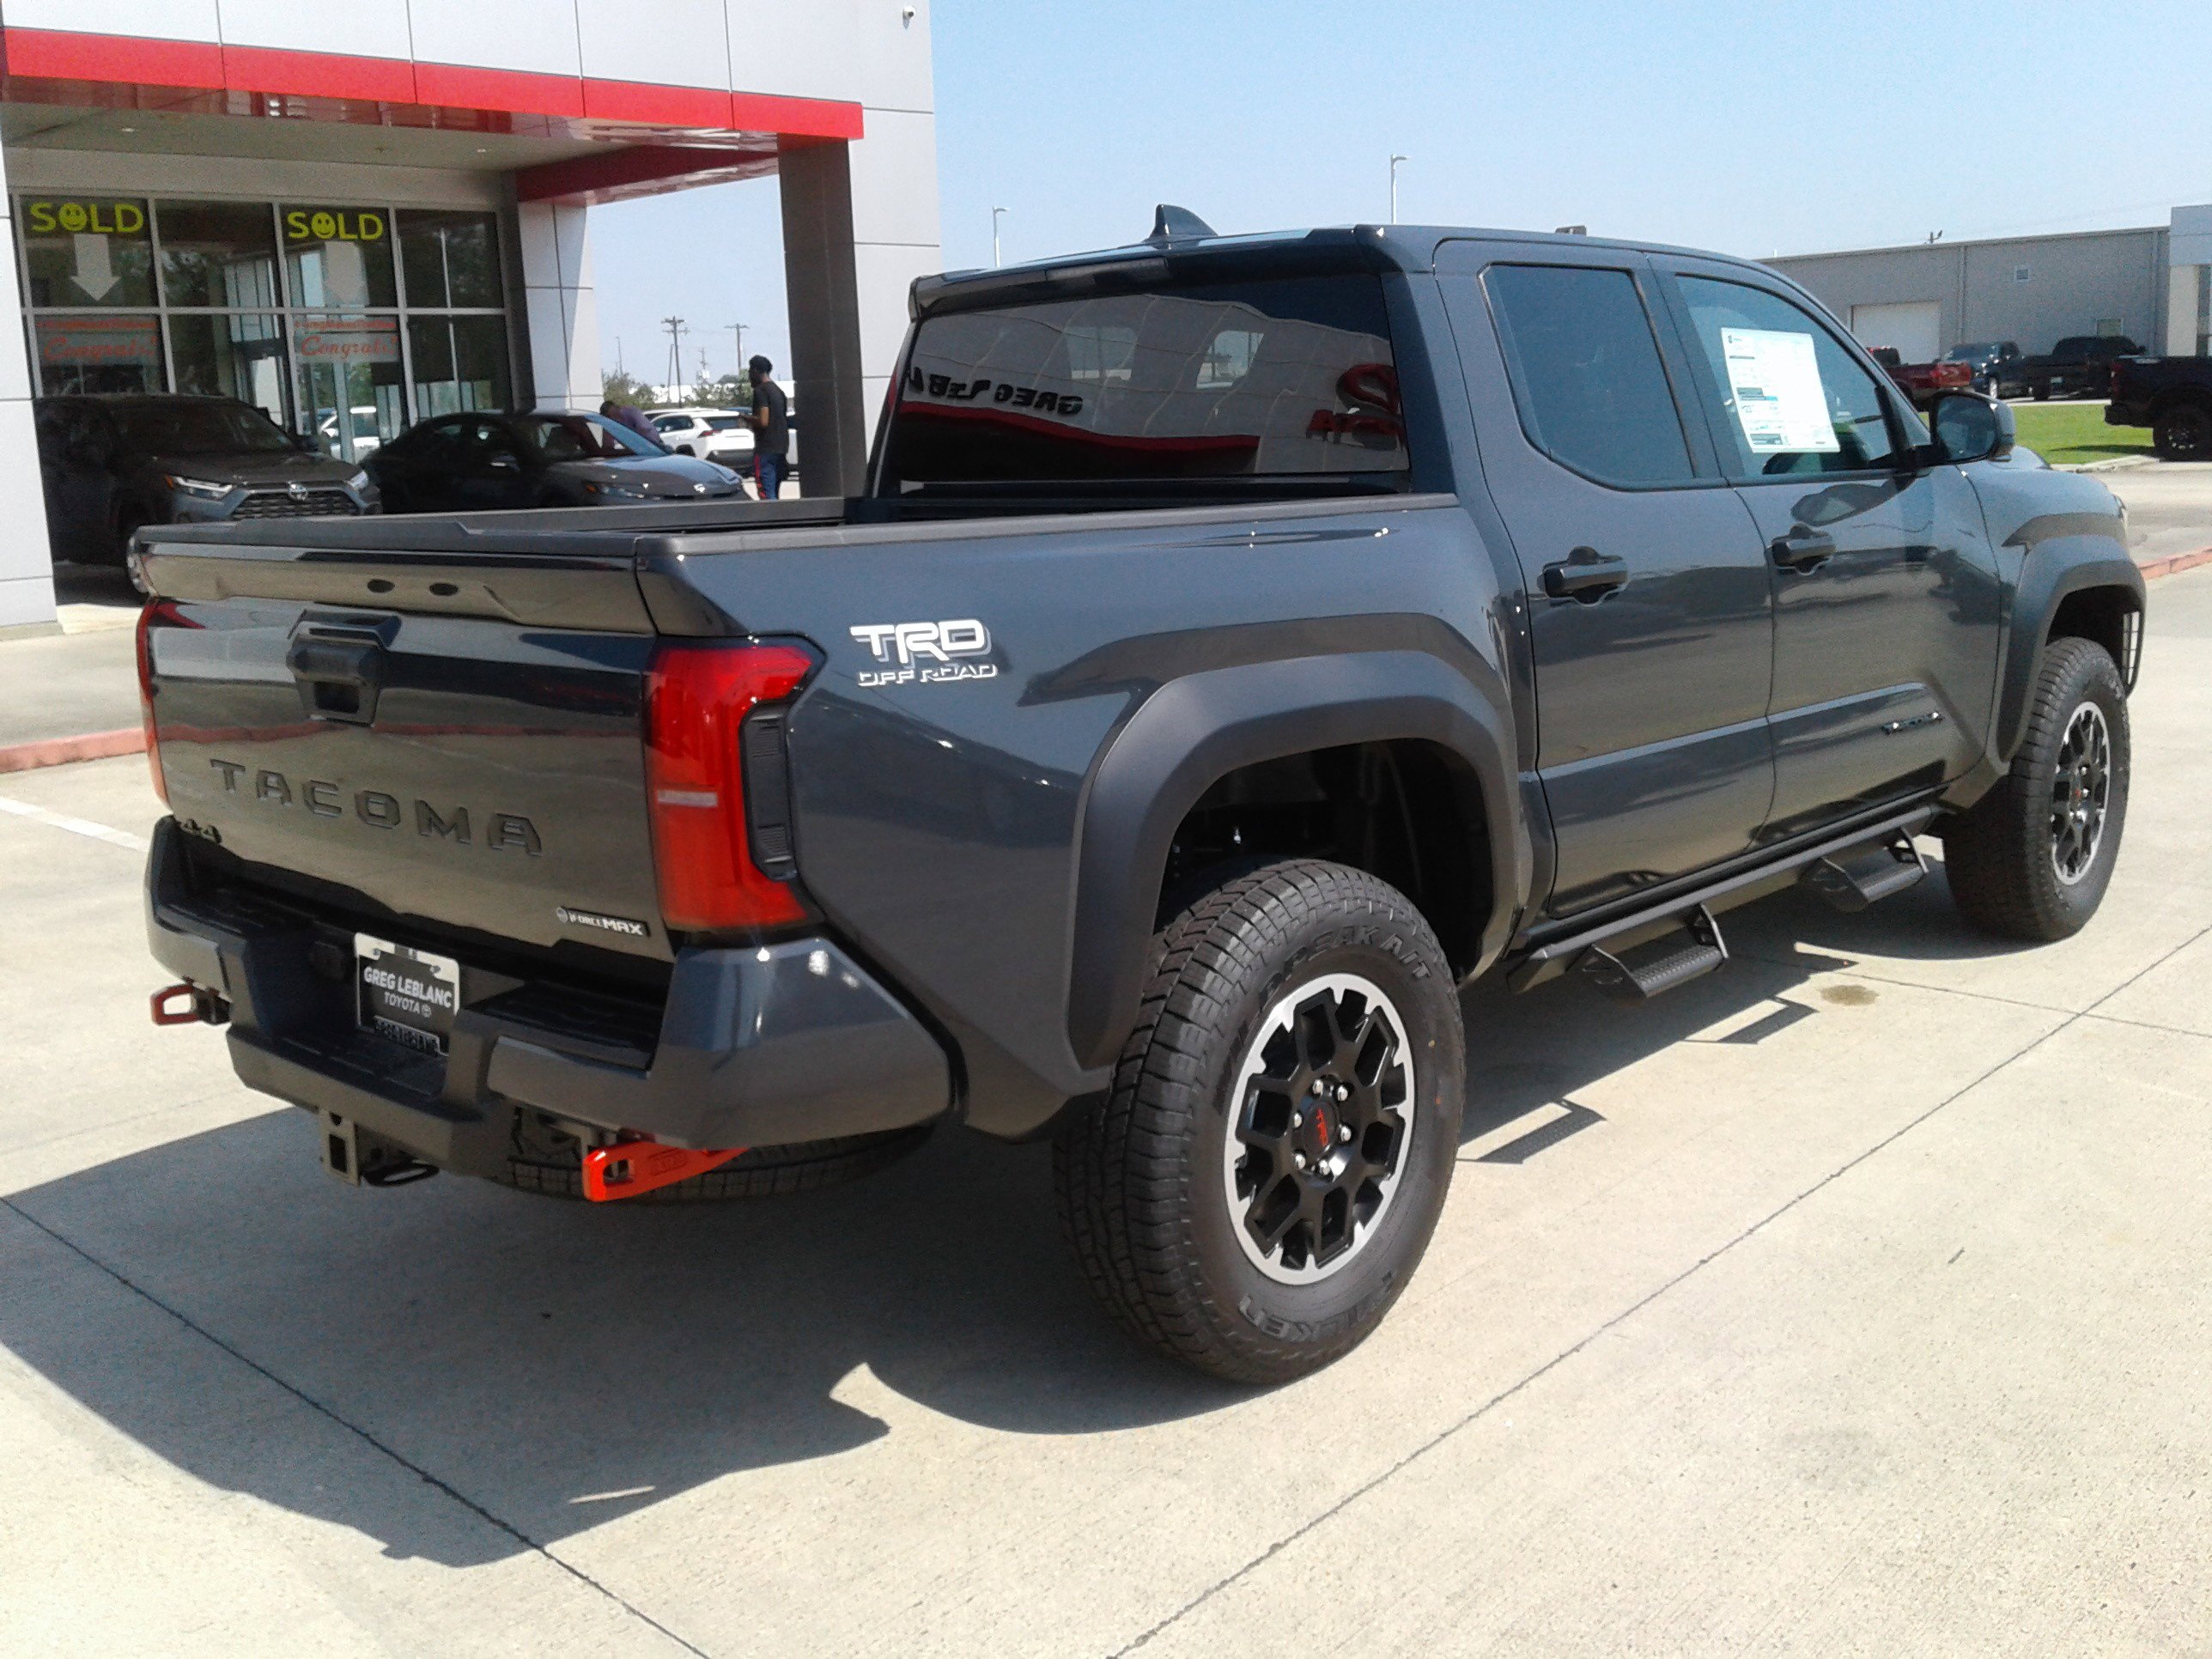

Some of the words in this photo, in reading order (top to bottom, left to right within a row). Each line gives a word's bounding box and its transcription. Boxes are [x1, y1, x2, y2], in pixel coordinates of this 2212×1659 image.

[849, 618, 989, 666] TRD
[859, 669, 915, 687] OFF
[920, 664, 998, 683] ROAD
[210, 757, 544, 858] TACOMA
[363, 965, 396, 990] GREG
[397, 975, 453, 1008] LEBLANC
[384, 991, 421, 1015] TOYOTA
